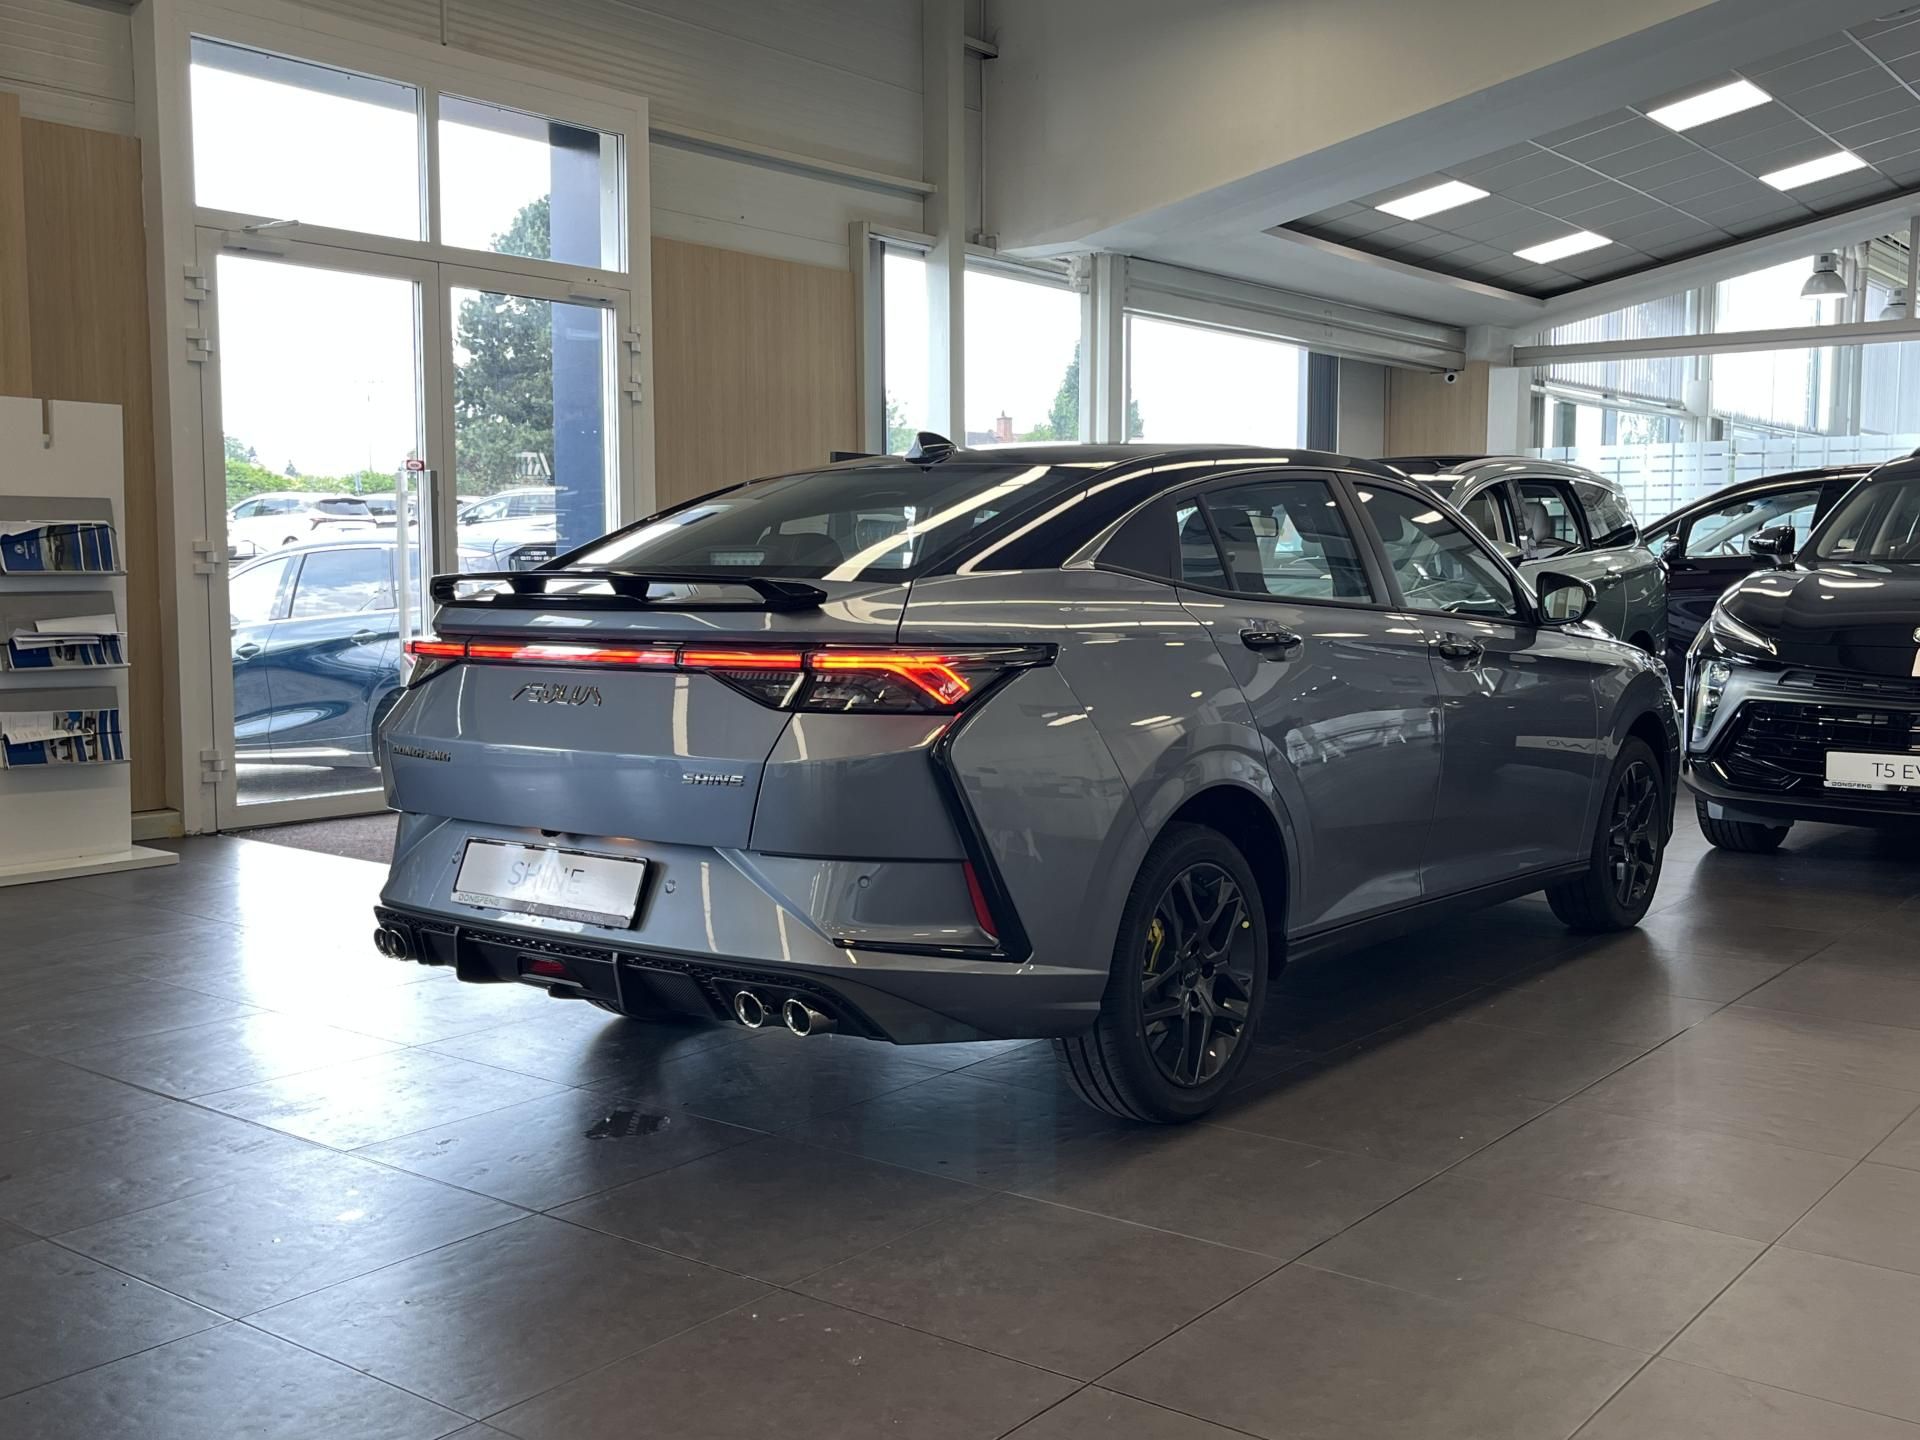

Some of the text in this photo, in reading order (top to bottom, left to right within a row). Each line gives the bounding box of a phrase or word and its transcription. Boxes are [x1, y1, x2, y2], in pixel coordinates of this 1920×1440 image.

[392, 744, 451, 762] DONGFENG
[1872, 763, 1895, 778] T5
[682, 773, 744, 787] SHINE
[1831, 781, 1873, 789] DONGFENG
[508, 860, 585, 895] SHINE
[458, 893, 500, 907] DONGFENG
